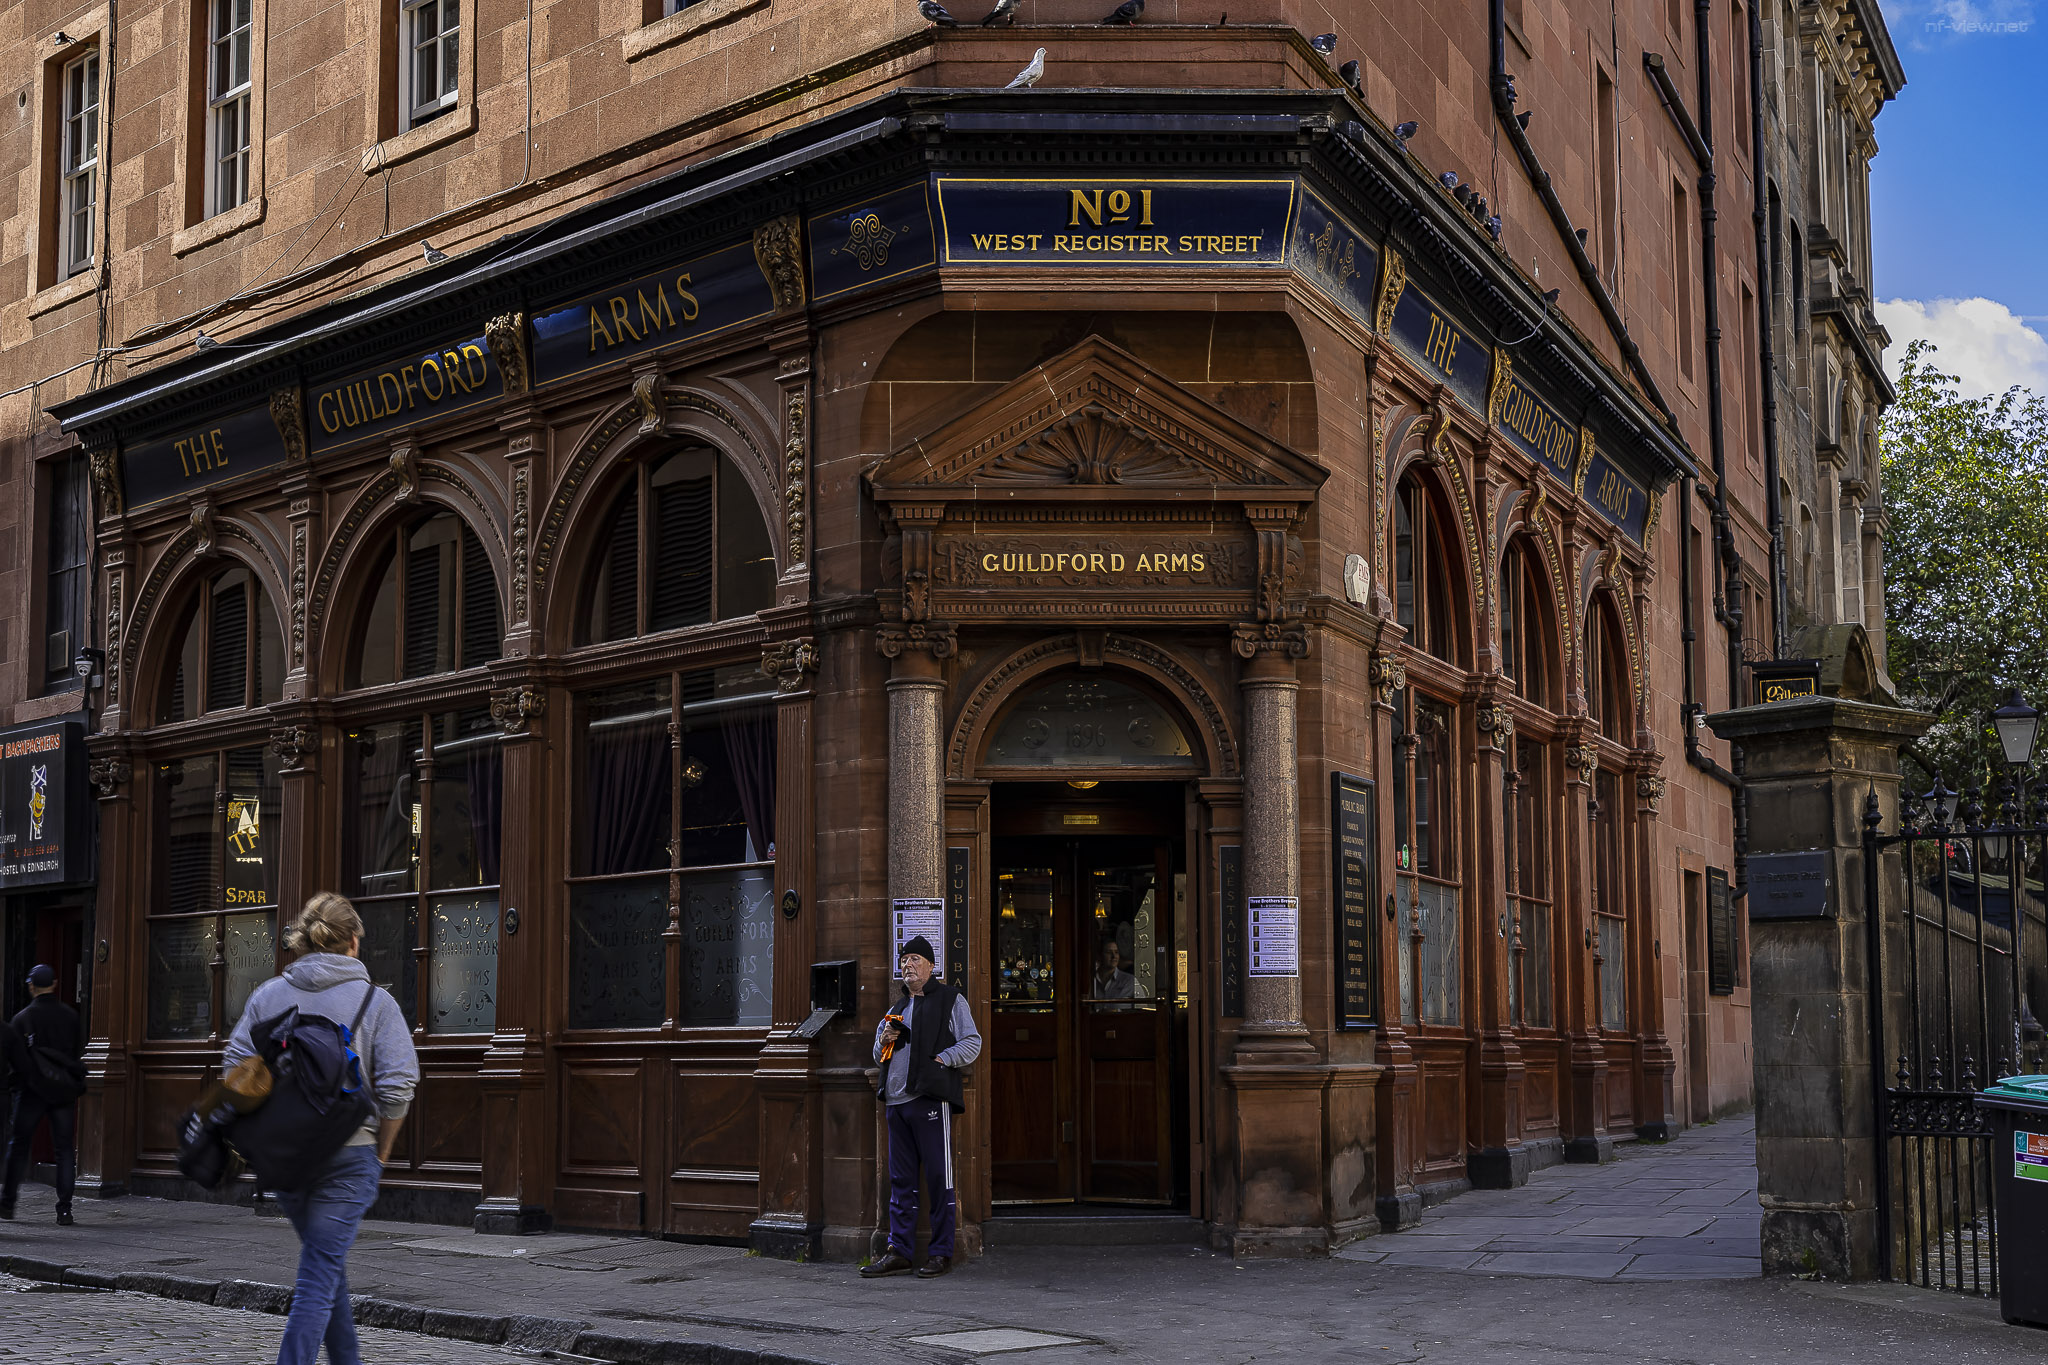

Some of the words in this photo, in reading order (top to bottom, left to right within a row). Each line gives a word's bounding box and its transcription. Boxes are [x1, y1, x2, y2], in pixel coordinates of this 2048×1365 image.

[971, 233, 1043, 251] WEST
[1053, 234, 1173, 256] REGISTER
[1179, 234, 1263, 254] STREET
[174, 428, 229, 477] THE
[317, 344, 488, 433] GUILDFORD
[588, 273, 700, 354] ARMS
[1424, 311, 1461, 376] THE
[1502, 382, 1574, 471] GUILDFORD
[1596, 467, 1633, 521] ARMS
[981, 553, 1125, 574] GUILDFORD
[1135, 553, 1206, 574] ARMS
[5, 733, 60, 759] BACKPACKERS
[1066, 723, 1105, 748] 1896
[27, 859, 59, 873] EDINBURGH
[953, 863, 964, 949] PUBLIC
[695, 923, 734, 943] GUILD
[1225, 863, 1237, 1000] RESTAURANT
[602, 961, 639, 980] ARMS
[715, 955, 757, 975] ARMS
[953, 962, 963, 988] BA
